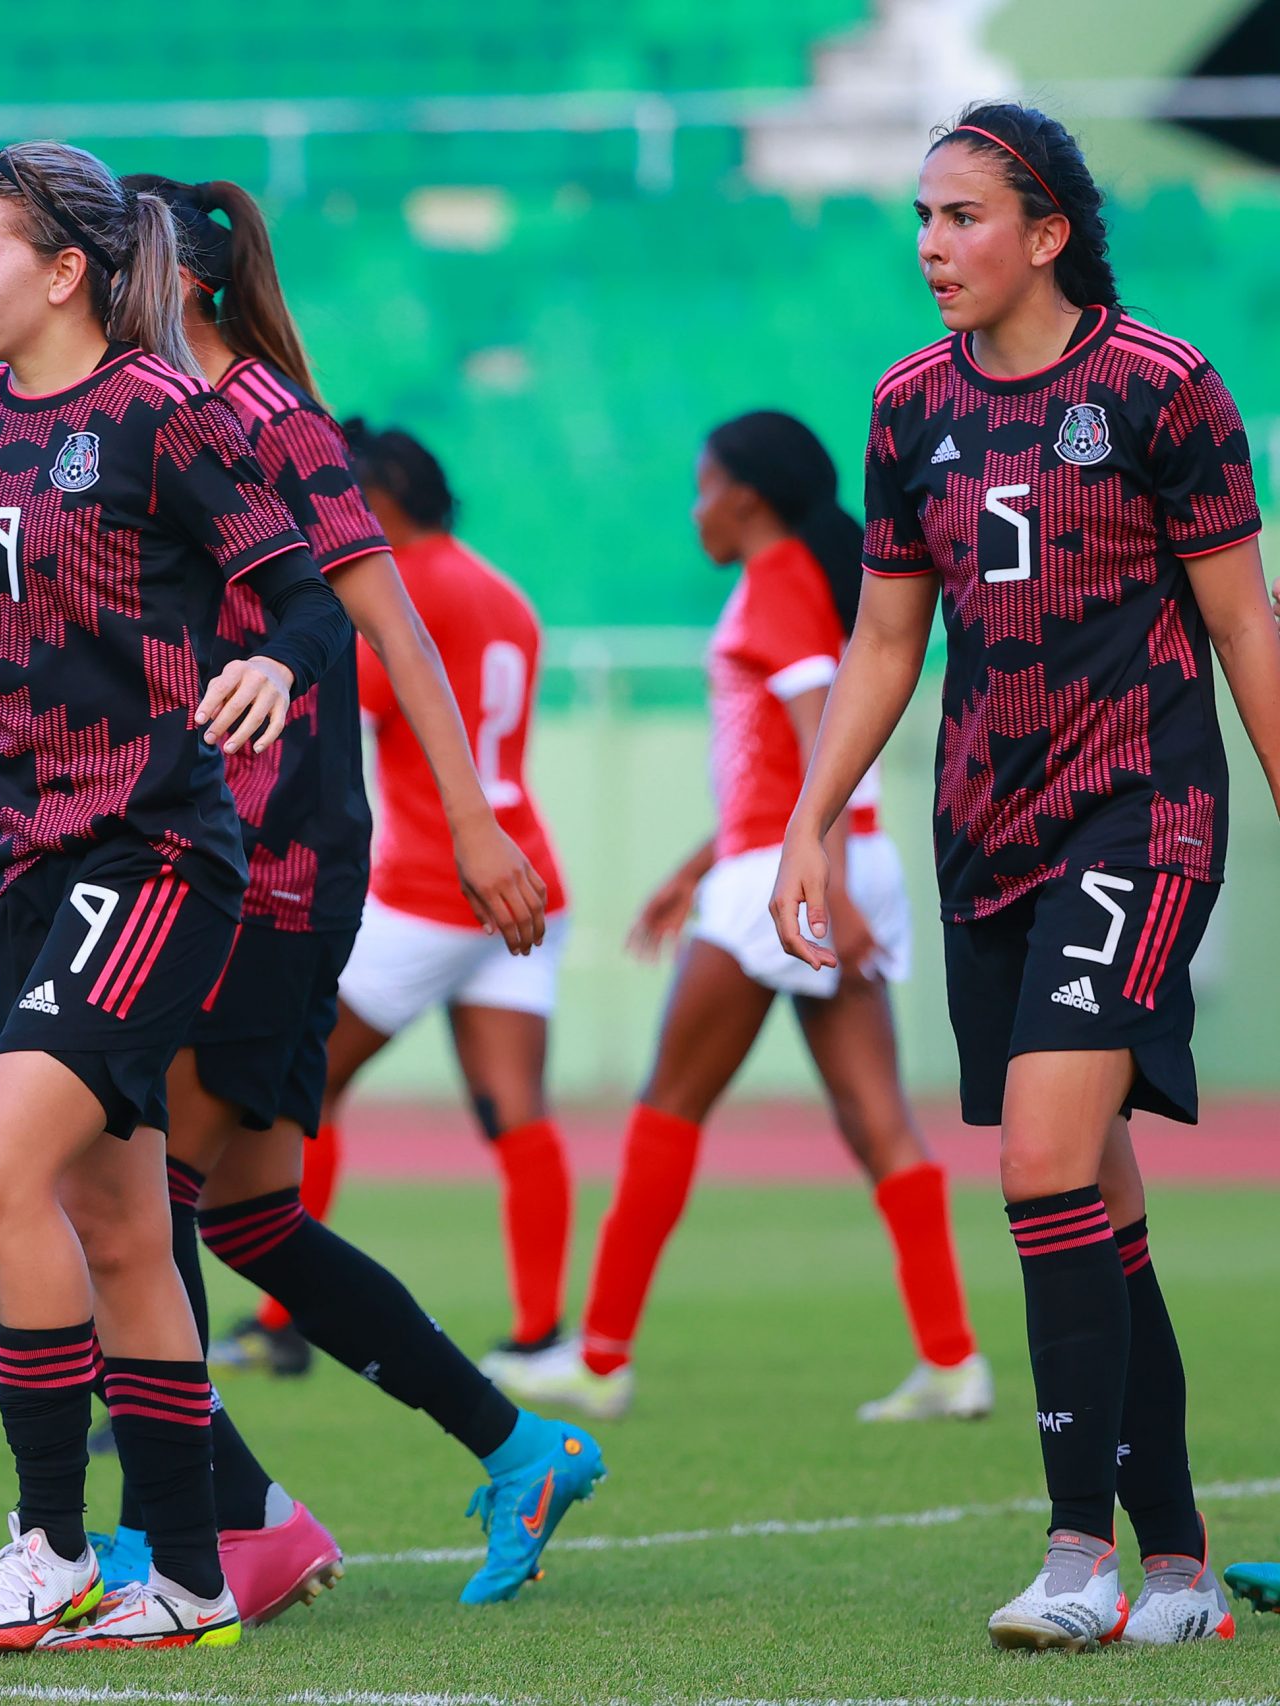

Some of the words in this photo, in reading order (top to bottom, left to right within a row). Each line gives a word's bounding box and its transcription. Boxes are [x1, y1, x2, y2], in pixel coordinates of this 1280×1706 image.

[931, 449, 961, 464] adidas
[984, 484, 1031, 583] 5
[70, 883, 120, 973] 9
[1062, 870, 1134, 965] 5
[19, 999, 60, 1016] adidas
[1050, 991, 1100, 1014] adidas
